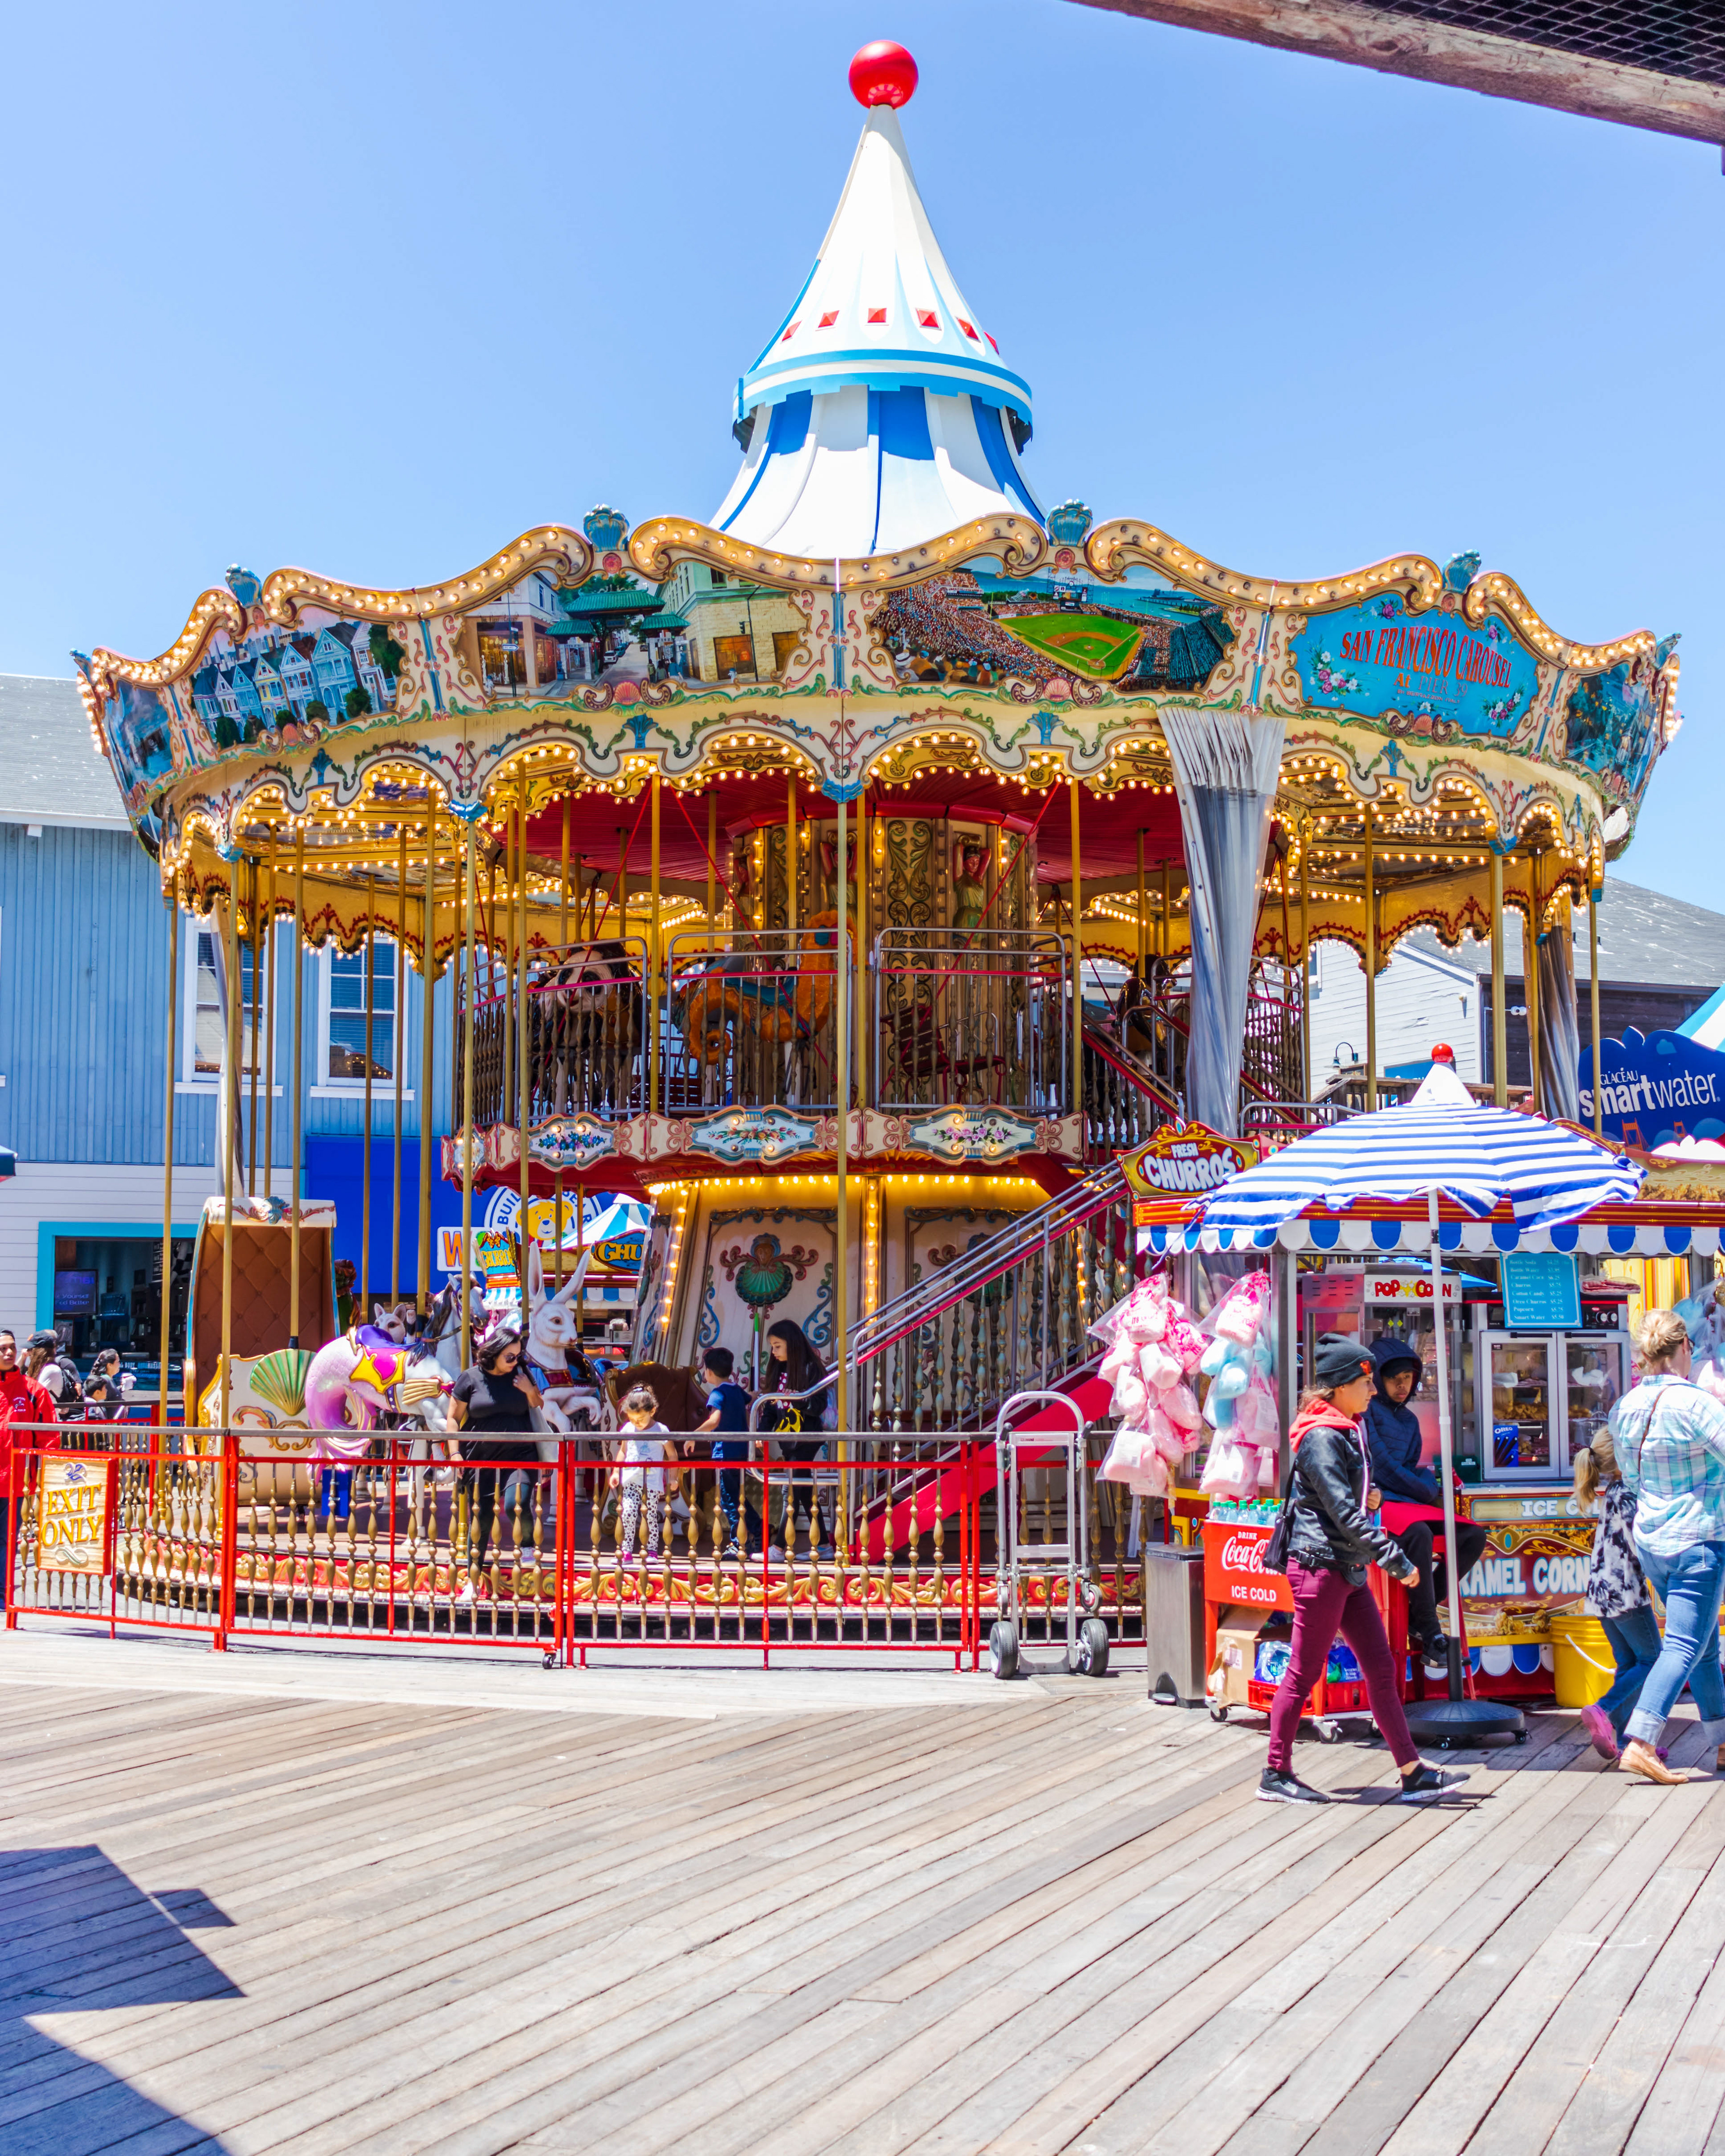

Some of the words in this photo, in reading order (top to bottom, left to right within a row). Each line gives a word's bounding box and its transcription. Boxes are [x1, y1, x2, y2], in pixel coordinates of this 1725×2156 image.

[1340, 630, 1375, 663] SAN
[1374, 626, 1456, 677] FRANCISCO
[1456, 635, 1512, 688] CAROUSEL
[1393, 673, 1411, 688] At
[1418, 676, 1448, 695] PIER
[1454, 682, 1468, 697] 39
[1407, 691, 1442, 701] BERTAZZON
[1600, 1067, 1638, 1085] GLACÉAU
[1579, 1069, 1716, 1117] smartwater
[1171, 1143, 1199, 1158] FRESH
[1144, 1147, 1236, 1191] CHURROS
[497, 1193, 521, 1225] BUIL
[1375, 1279, 1400, 1297] POP
[1415, 1279, 1451, 1297] CON
[46, 1483, 101, 1515] EXIT
[1522, 1500, 1558, 1517] ICE
[42, 1514, 104, 1546] ONLY
[1238, 1531, 1257, 1540] DRINK
[1533, 1555, 1591, 1594] CORN
[1231, 1585, 1247, 1599] ICE
[1250, 1587, 1276, 1602] COLD
